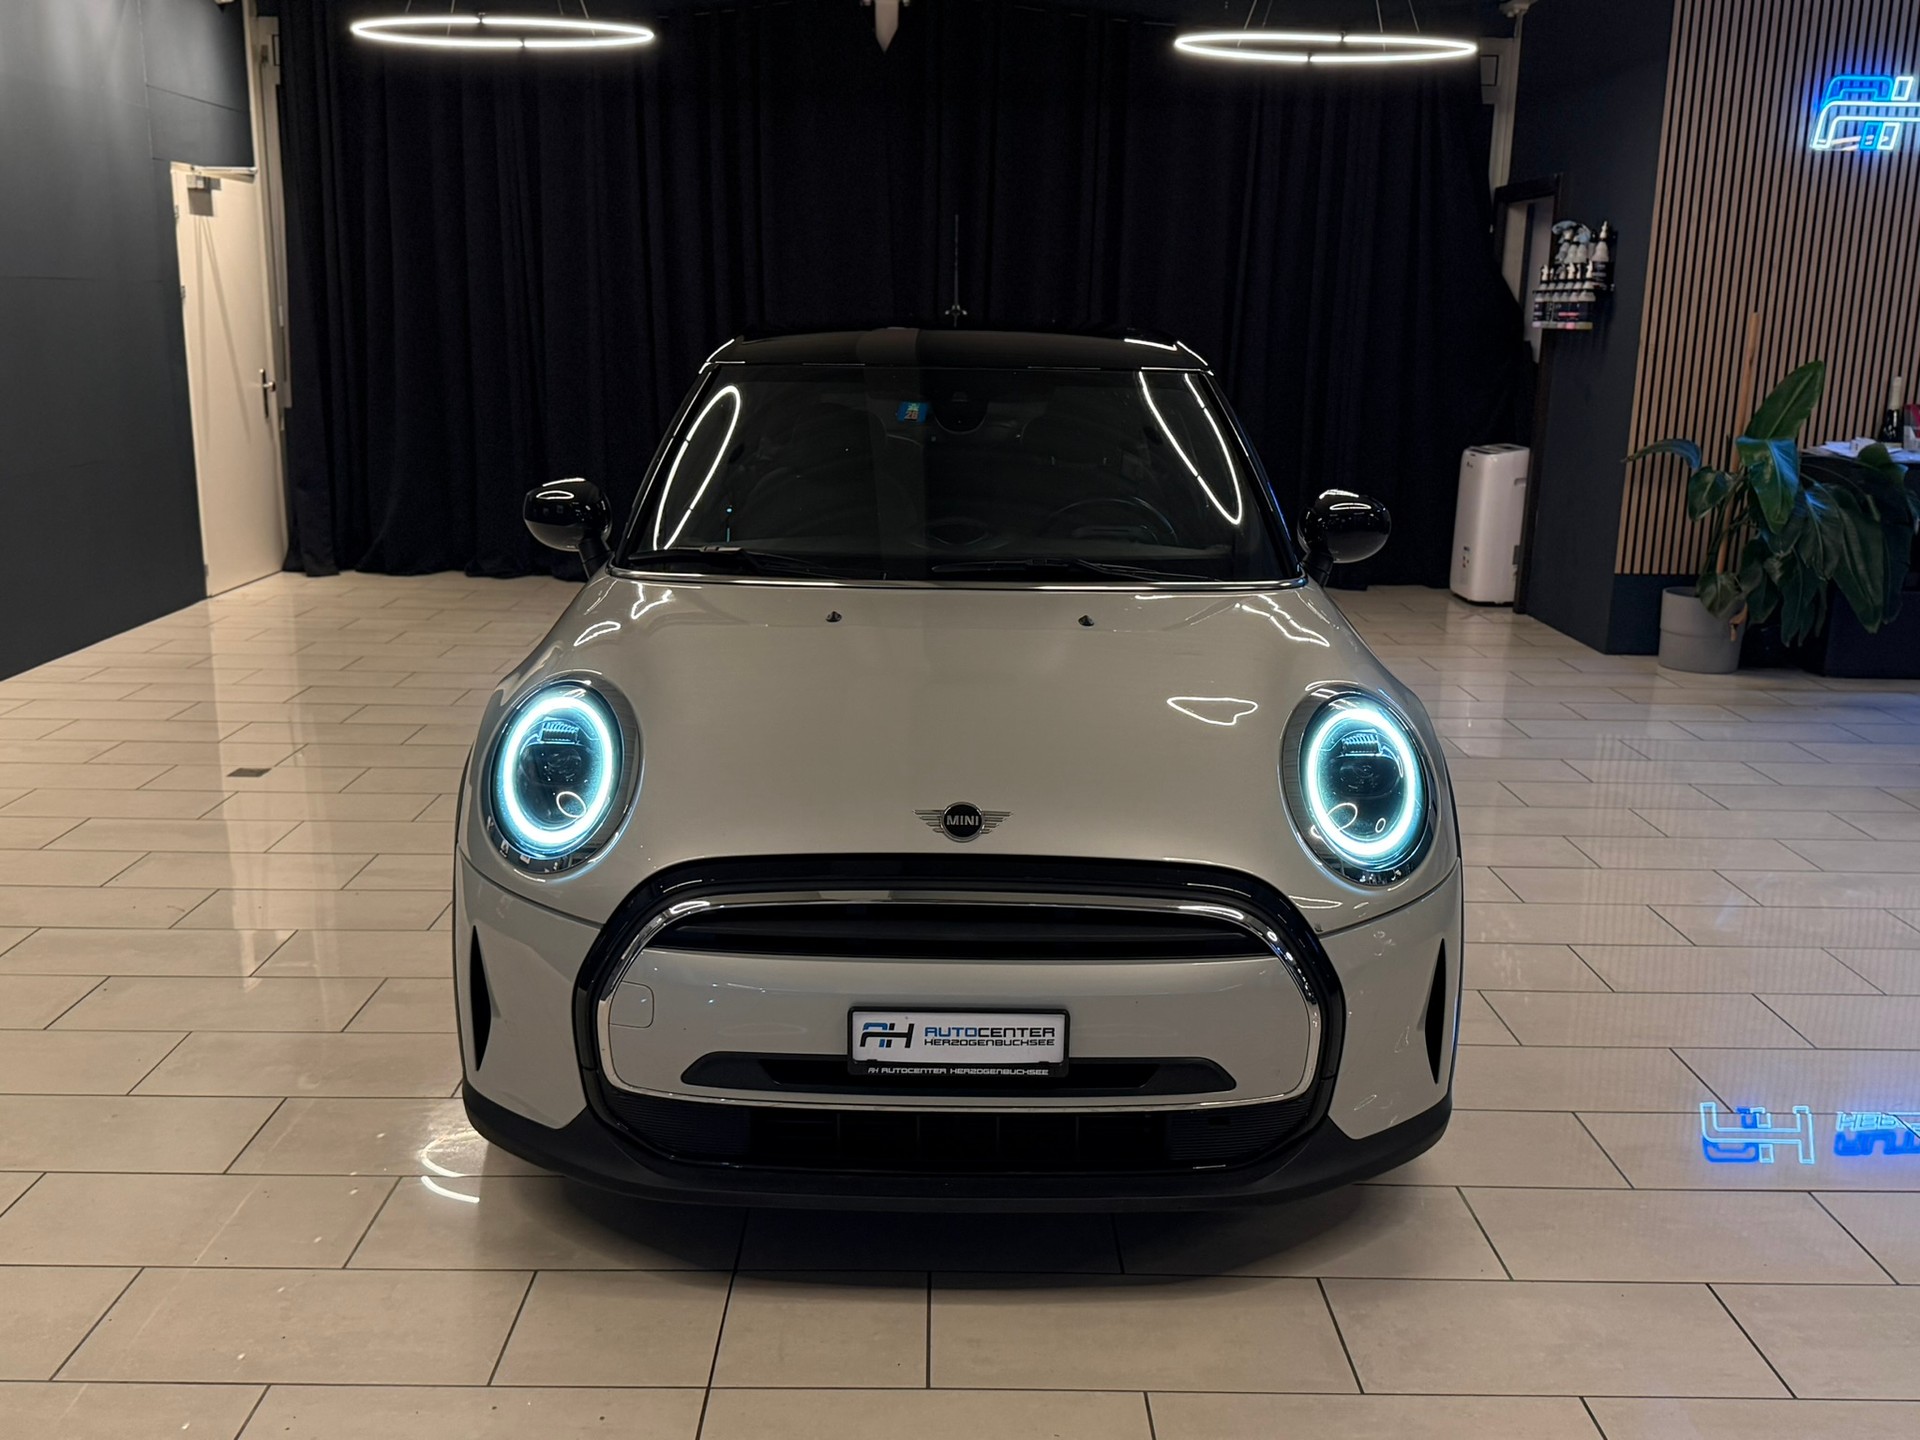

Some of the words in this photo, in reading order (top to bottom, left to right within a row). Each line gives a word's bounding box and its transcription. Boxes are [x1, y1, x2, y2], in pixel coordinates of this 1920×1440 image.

[946, 815, 979, 826] MINI
[924, 1026, 1055, 1038] AUTOCENTER
[924, 1038, 1055, 1047] HERZOGENBUCHSEE
